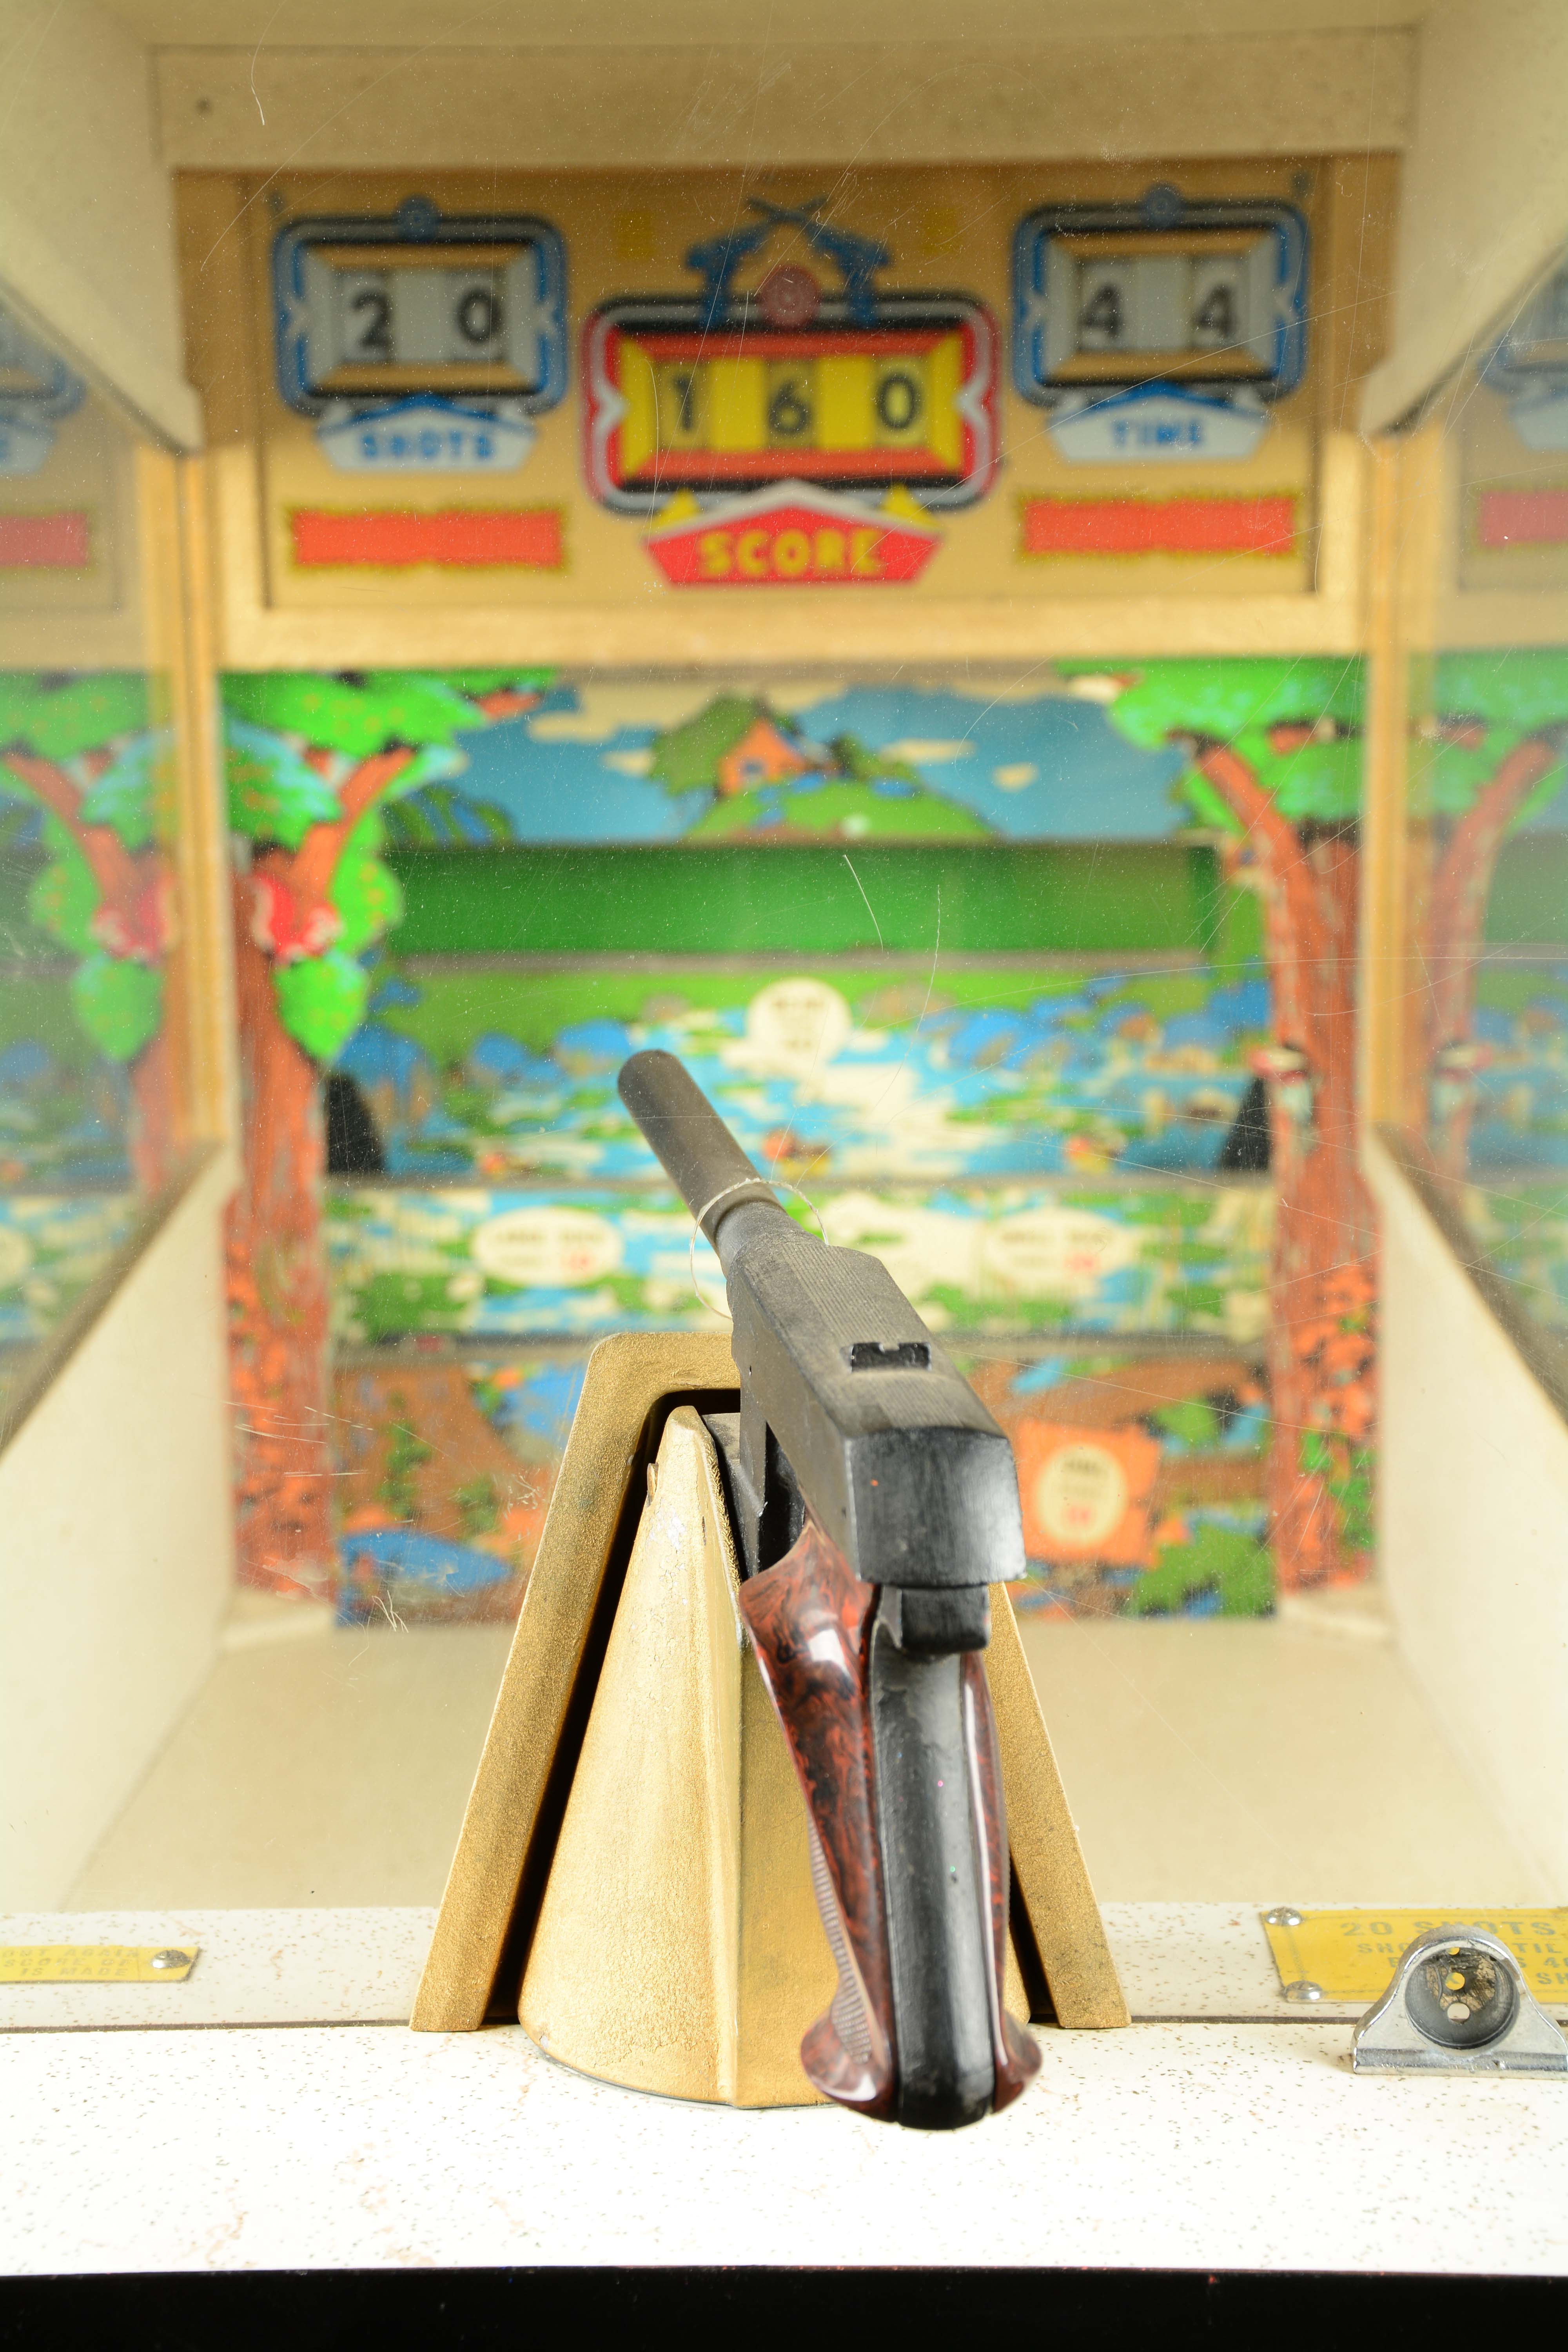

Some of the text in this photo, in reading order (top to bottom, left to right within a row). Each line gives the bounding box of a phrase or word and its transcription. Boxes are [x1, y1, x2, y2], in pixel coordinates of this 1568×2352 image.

[699, 527, 884, 579] SCORE
[1341, 1920, 1555, 1936] 20 SOTS
[4, 1958, 86, 1967] SCORE
[21, 1967, 129, 1976] IS MADE
